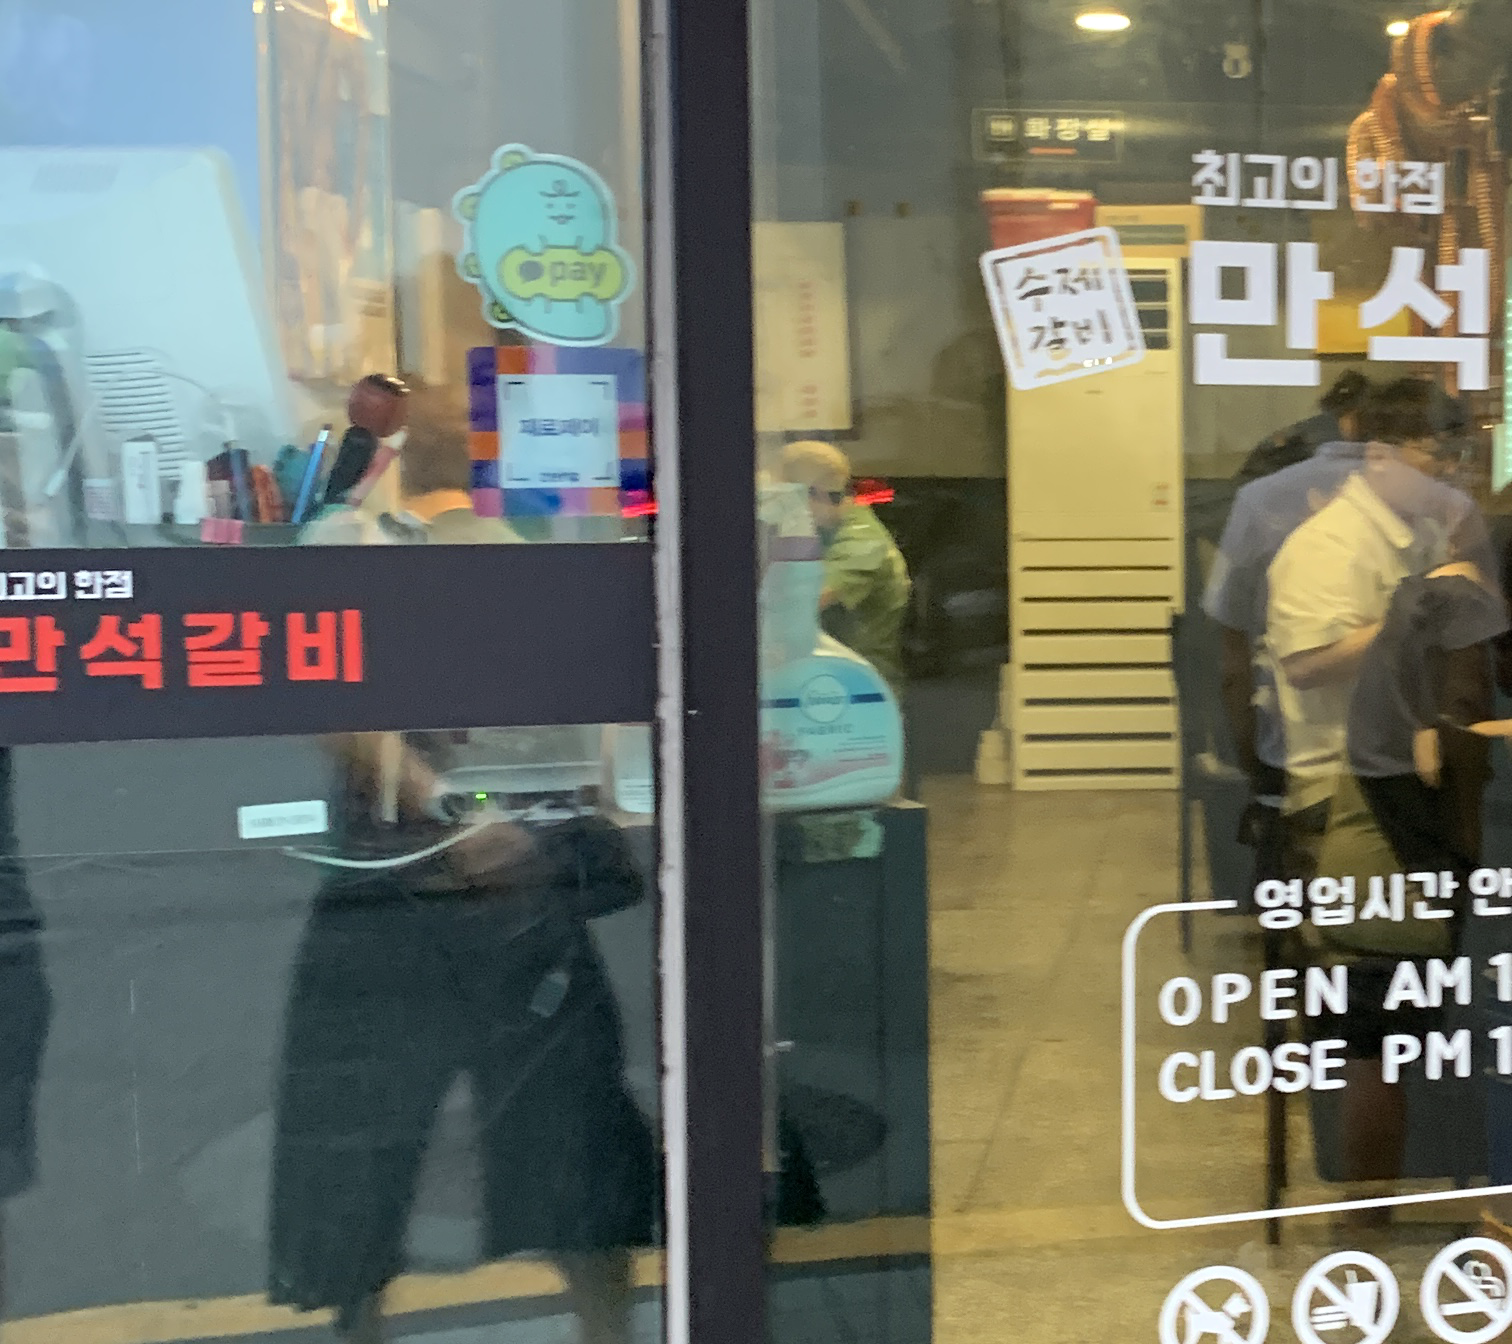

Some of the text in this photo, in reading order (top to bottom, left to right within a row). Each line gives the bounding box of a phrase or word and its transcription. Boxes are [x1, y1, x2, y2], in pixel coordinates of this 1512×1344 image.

[1191, 149, 1446, 215] 최고의 한점
[549, 261, 607, 289] pay
[1014, 266, 1106, 313] 수제
[1028, 308, 1113, 358] 갈비
[73, 569, 135, 600] 한점
[0, 608, 364, 693] 만석갈비
[1253, 870, 1460, 930] 영업시간
[1158, 964, 1350, 1027] OPEN
[1382, 957, 1473, 1013] AM
[1158, 1039, 1350, 1103] CLOSE
[1381, 1027, 1473, 1085] PM
